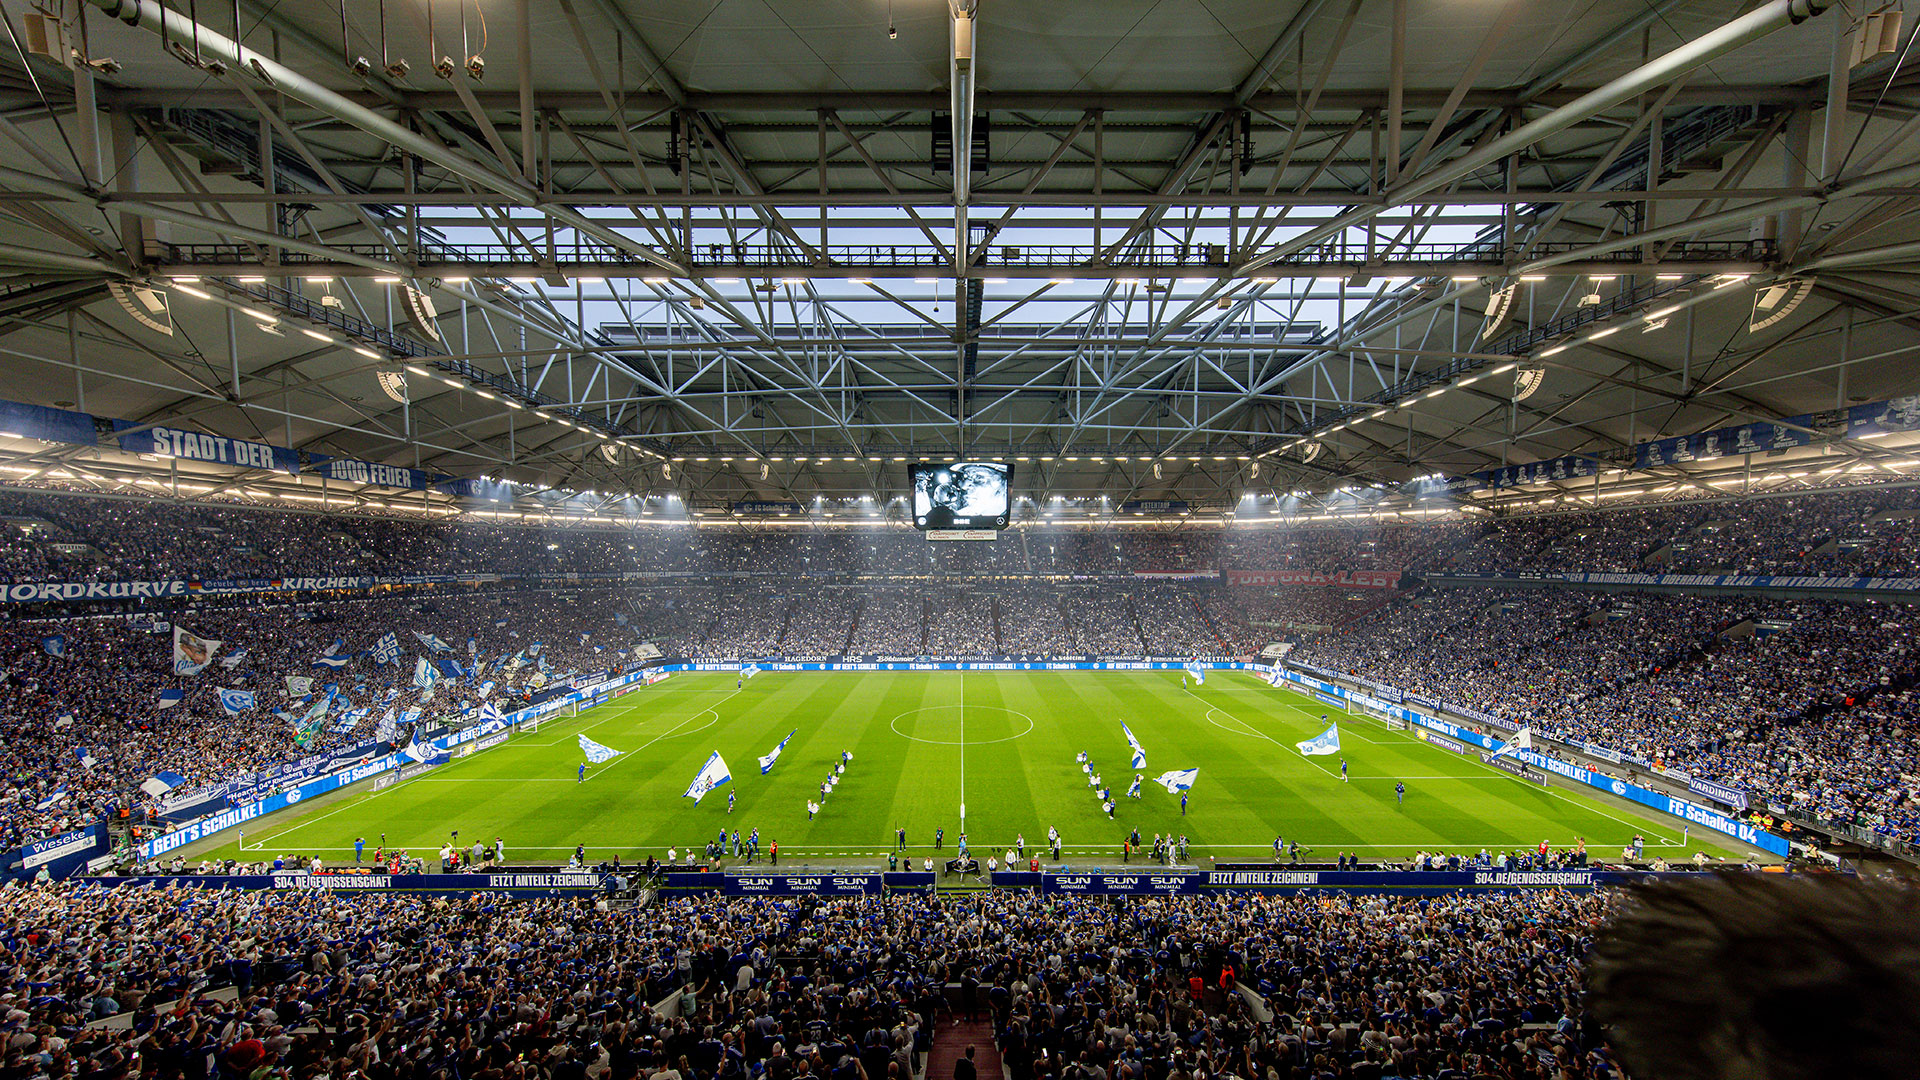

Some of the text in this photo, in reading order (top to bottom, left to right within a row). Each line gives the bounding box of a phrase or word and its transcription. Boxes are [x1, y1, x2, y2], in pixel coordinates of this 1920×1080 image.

[152, 427, 274, 469] STADT DER
[331, 461, 412, 488] 1000 FEUER
[1228, 570, 1399, 588] FORTUNA LEBT
[1661, 574, 1720, 586] OBERRANG
[1721, 575, 1757, 586] BLAU
[1769, 576, 1860, 588] UNTERRANG
[842, 655, 863, 663] HRS
[1419, 715, 1427, 725] FC
[1427, 718, 1449, 735] Schalke
[1448, 703, 1525, 732] MENGERSKIRCHEN
[1429, 735, 1462, 754] MERKUR
[339, 770, 351, 786] FC
[352, 761, 385, 781] Schalke
[1547, 758, 1587, 783] SCHALKE
[153, 801, 264, 855] GEHT'S SCHALKE !
[1669, 799, 1758, 844] FC Schalke 04
[32, 830, 86, 853] Weseke
[489, 875, 600, 887] JETZT ANTEILE ZEICHNEN!
[1208, 872, 1319, 884] JETZT ANTEILE ZEICHNEN!
[1475, 873, 1592, 885] S04.DE/GENOSSENSCHAFT
[810, 1029, 822, 1041] 23
